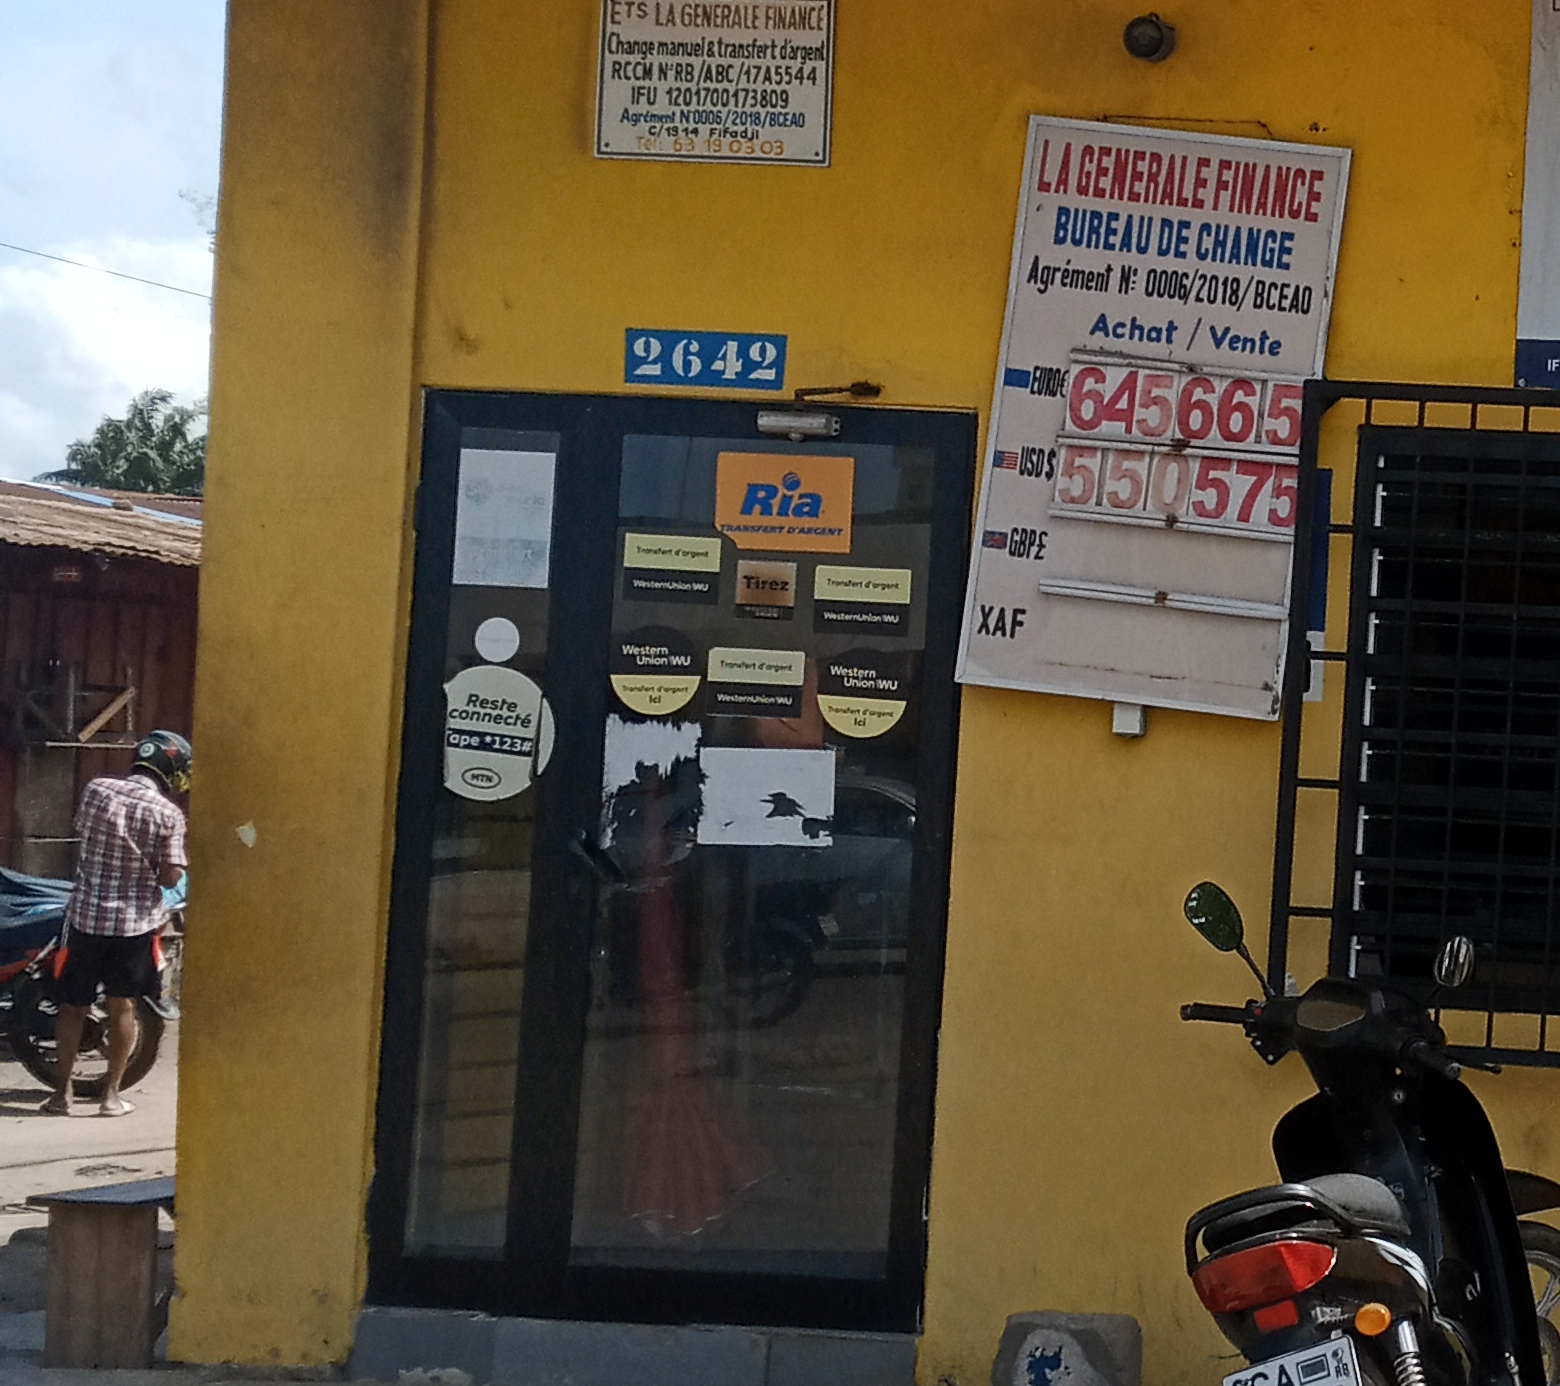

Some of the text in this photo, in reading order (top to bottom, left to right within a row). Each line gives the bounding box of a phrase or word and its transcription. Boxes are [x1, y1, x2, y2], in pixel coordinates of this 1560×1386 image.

[655, 2, 676, 27] LA
[681, 3, 760, 30] GENERALE
[764, 5, 825, 32] FINANCE
[607, 32, 655, 61] Change
[657, 36, 705, 57] manuel
[706, 40, 716, 58] &
[717, 36, 777, 60] transfert
[611, 60, 653, 82] RCCM
[631, 85, 790, 110] IFU 1201700173809
[620, 107, 676, 127] Agrément
[709, 126, 760, 142] Fifadji
[673, 137, 695, 153] 63
[704, 138, 722, 153] 19
[760, 140, 784, 156] 03
[1037, 139, 1325, 223] LA GENERALE FINANCE
[1053, 206, 1296, 271] BUREAU DE CHANGE
[1026, 255, 1114, 295] Agrément
[1089, 313, 1178, 345] Achat
[1209, 325, 1283, 358] Vente
[632, 335, 779, 382] 2642
[740, 472, 822, 519] Ria
[720, 523, 843, 537] TRANSFERT D'ARGENT
[636, 545, 673, 557] Transfert
[743, 575, 790, 592] Tirez
[827, 578, 863, 588] Transfert
[976, 604, 1027, 639] XAF
[622, 644, 669, 655] Western
[636, 655, 668, 666] Union
[720, 660, 757, 670] Transfert
[830, 666, 876, 678] Western
[844, 677, 875, 688] Union
[466, 693, 518, 713] Reste
[648, 695, 662, 704] Ici
[448, 708, 532, 728] connecté
[854, 718, 866, 727] Ici
[470, 773, 493, 783] MTN
[1335, 1362, 1350, 1379] RB
